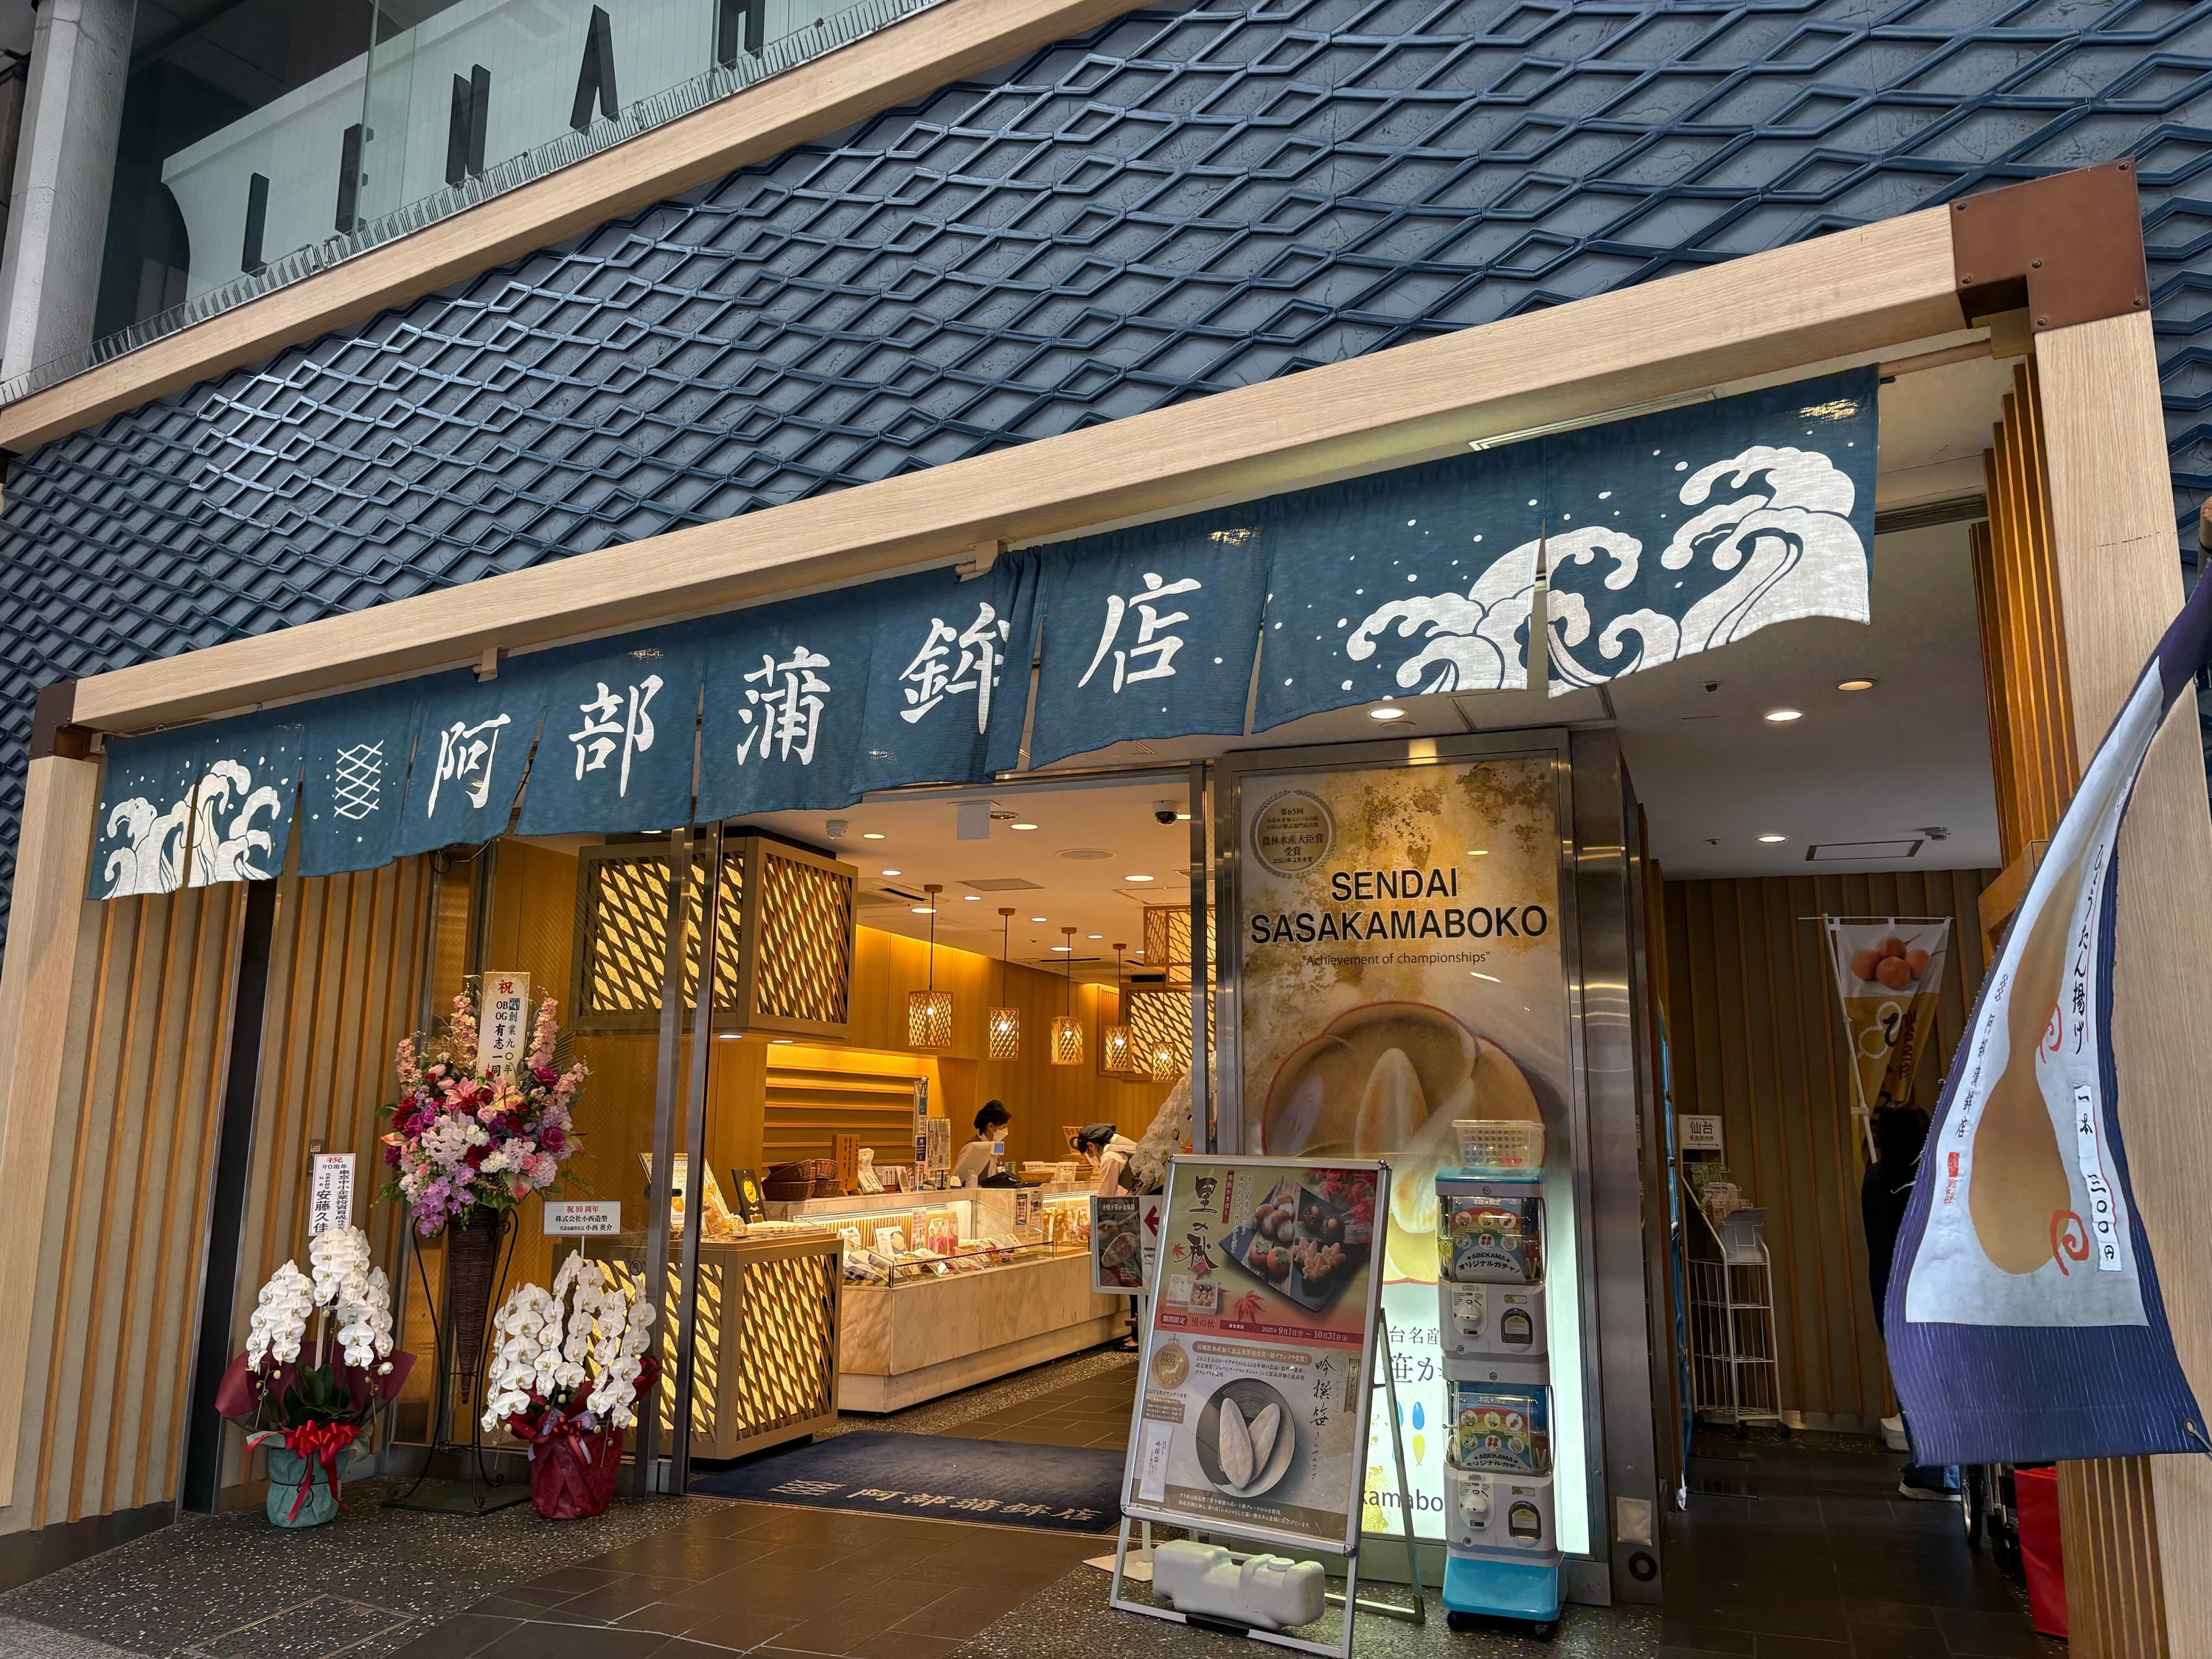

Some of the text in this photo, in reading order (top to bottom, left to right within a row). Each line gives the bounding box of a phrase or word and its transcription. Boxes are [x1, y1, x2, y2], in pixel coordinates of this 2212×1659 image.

[428, 572, 1202, 819] 阿部蒲鉾店
[1262, 833, 1324, 846] 農林水産大臣賞
[1331, 867, 1458, 901] SENDAI
[1251, 905, 1548, 945] SASAKAMABOKO
[1303, 952, 1491, 967] "Achievement of championships"
[498, 979, 514, 994] 祝
[495, 1012, 508, 1020] OG
[496, 1001, 508, 1009] OB
[491, 1023, 506, 1077] 有志一同
[1689, 1121, 1714, 1135] 仙台
[1224, 1175, 1234, 1215] 季節かまぼこ
[313, 1189, 332, 1233] 安藤久佳
[1472, 1252, 1506, 1260] ABEKAMA
[1161, 1315, 1215, 1328] 期間限定 里の秋
[1391, 1352, 1442, 1383] 笹か
[1310, 1355, 1337, 1427] 吟撰笹
[1348, 1366, 1357, 1407] ザ・プレミアム
[1479, 1453, 1513, 1462] ABEKAMA
[846, 1488, 1104, 1521] 阿部蒲鉾店
